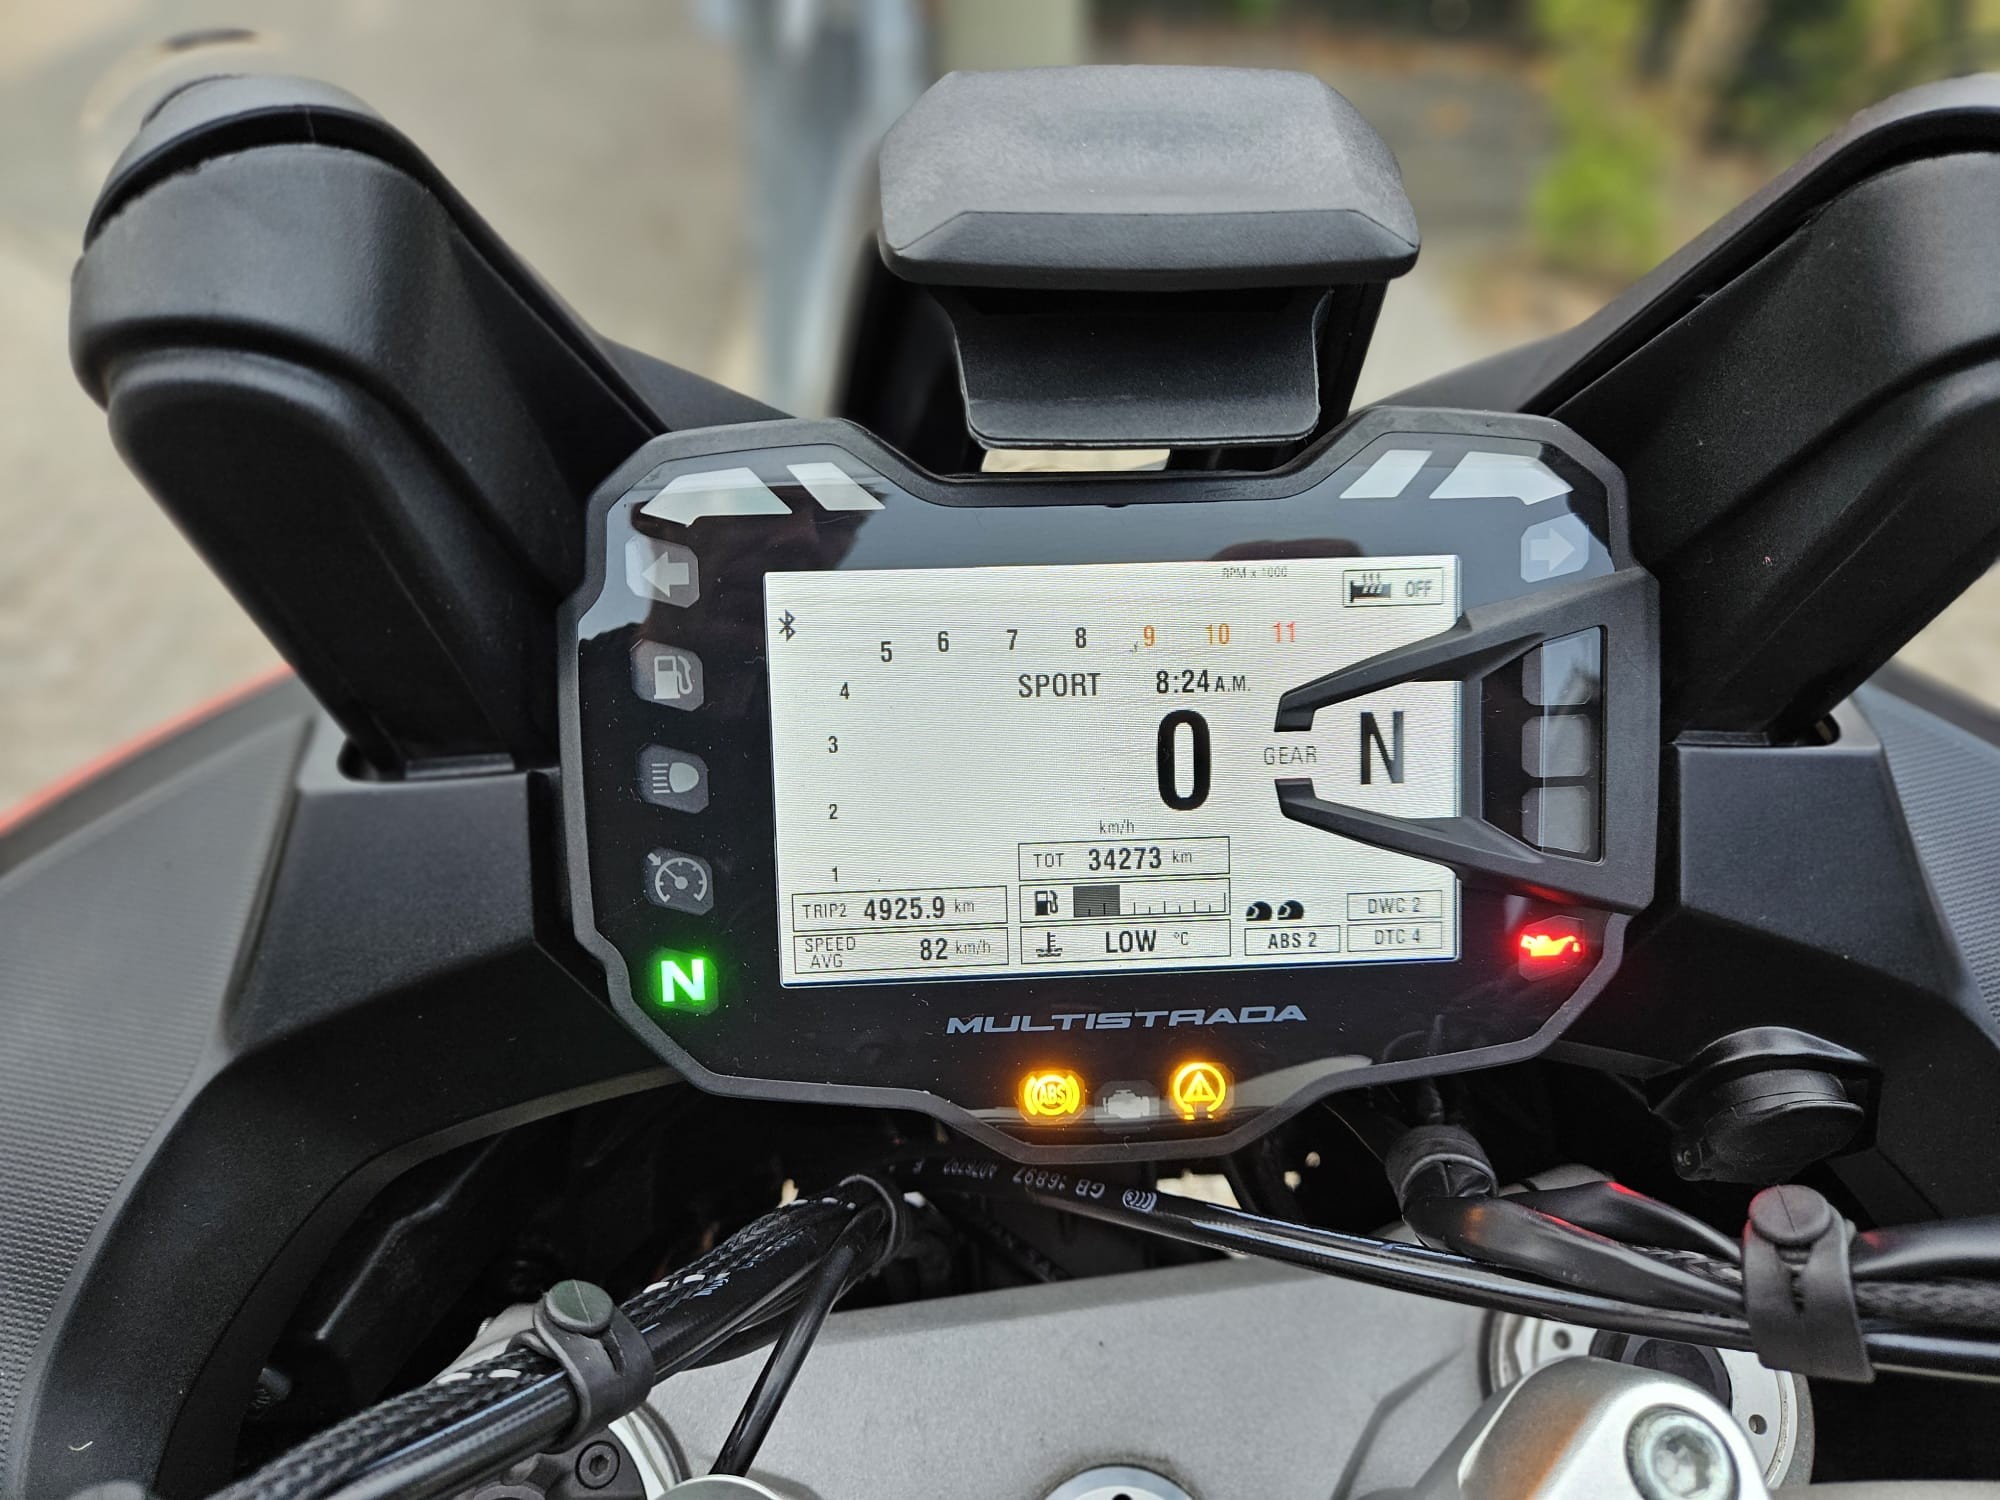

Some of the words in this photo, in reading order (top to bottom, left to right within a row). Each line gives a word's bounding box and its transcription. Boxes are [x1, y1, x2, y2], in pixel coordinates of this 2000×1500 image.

[1222, 568, 1247, 579] RPM
[1261, 566, 1288, 577] 1000
[1404, 580, 1433, 598] OFF
[937, 631, 949, 652] 6
[1006, 629, 1018, 650] 7
[1075, 627, 1087, 649] 8
[1143, 625, 1156, 647] 9
[1206, 623, 1231, 645] 10
[1273, 622, 1296, 643] 11
[881, 641, 892, 662] 5
[840, 683, 850, 700] 4
[1018, 672, 1101, 698] SPORT
[1156, 669, 1211, 694] 8:24
[828, 736, 838, 753] 3
[1360, 710, 1404, 785] N
[1156, 709, 1212, 811] 0
[1263, 746, 1317, 766] GEAR
[828, 804, 838, 819] 2
[1099, 819, 1135, 835] km/h
[1033, 852, 1065, 868] TOT
[1087, 847, 1162, 871] 34273
[1172, 849, 1193, 864] km
[831, 867, 839, 882] 1
[802, 903, 848, 919] TRIP2
[864, 896, 945, 921] 4925.9
[954, 899, 975, 913] km
[1367, 897, 1407, 914] DWC
[1412, 896, 1422, 912] 2
[804, 936, 856, 952] SPEED
[1105, 929, 1157, 954] LOW
[1267, 933, 1301, 949] ABS
[1307, 932, 1318, 948] 2
[1374, 928, 1407, 945] DTC
[1411, 927, 1421, 943] 4
[919, 938, 949, 960] 82
[955, 940, 991, 955] km/h
[810, 953, 843, 968] AVG
[660, 958, 706, 1003] N
[946, 1004, 1308, 1034] MULTISTRADA
[1039, 1083, 1066, 1100] ABS
[1075, 1179, 1105, 1199] GB
